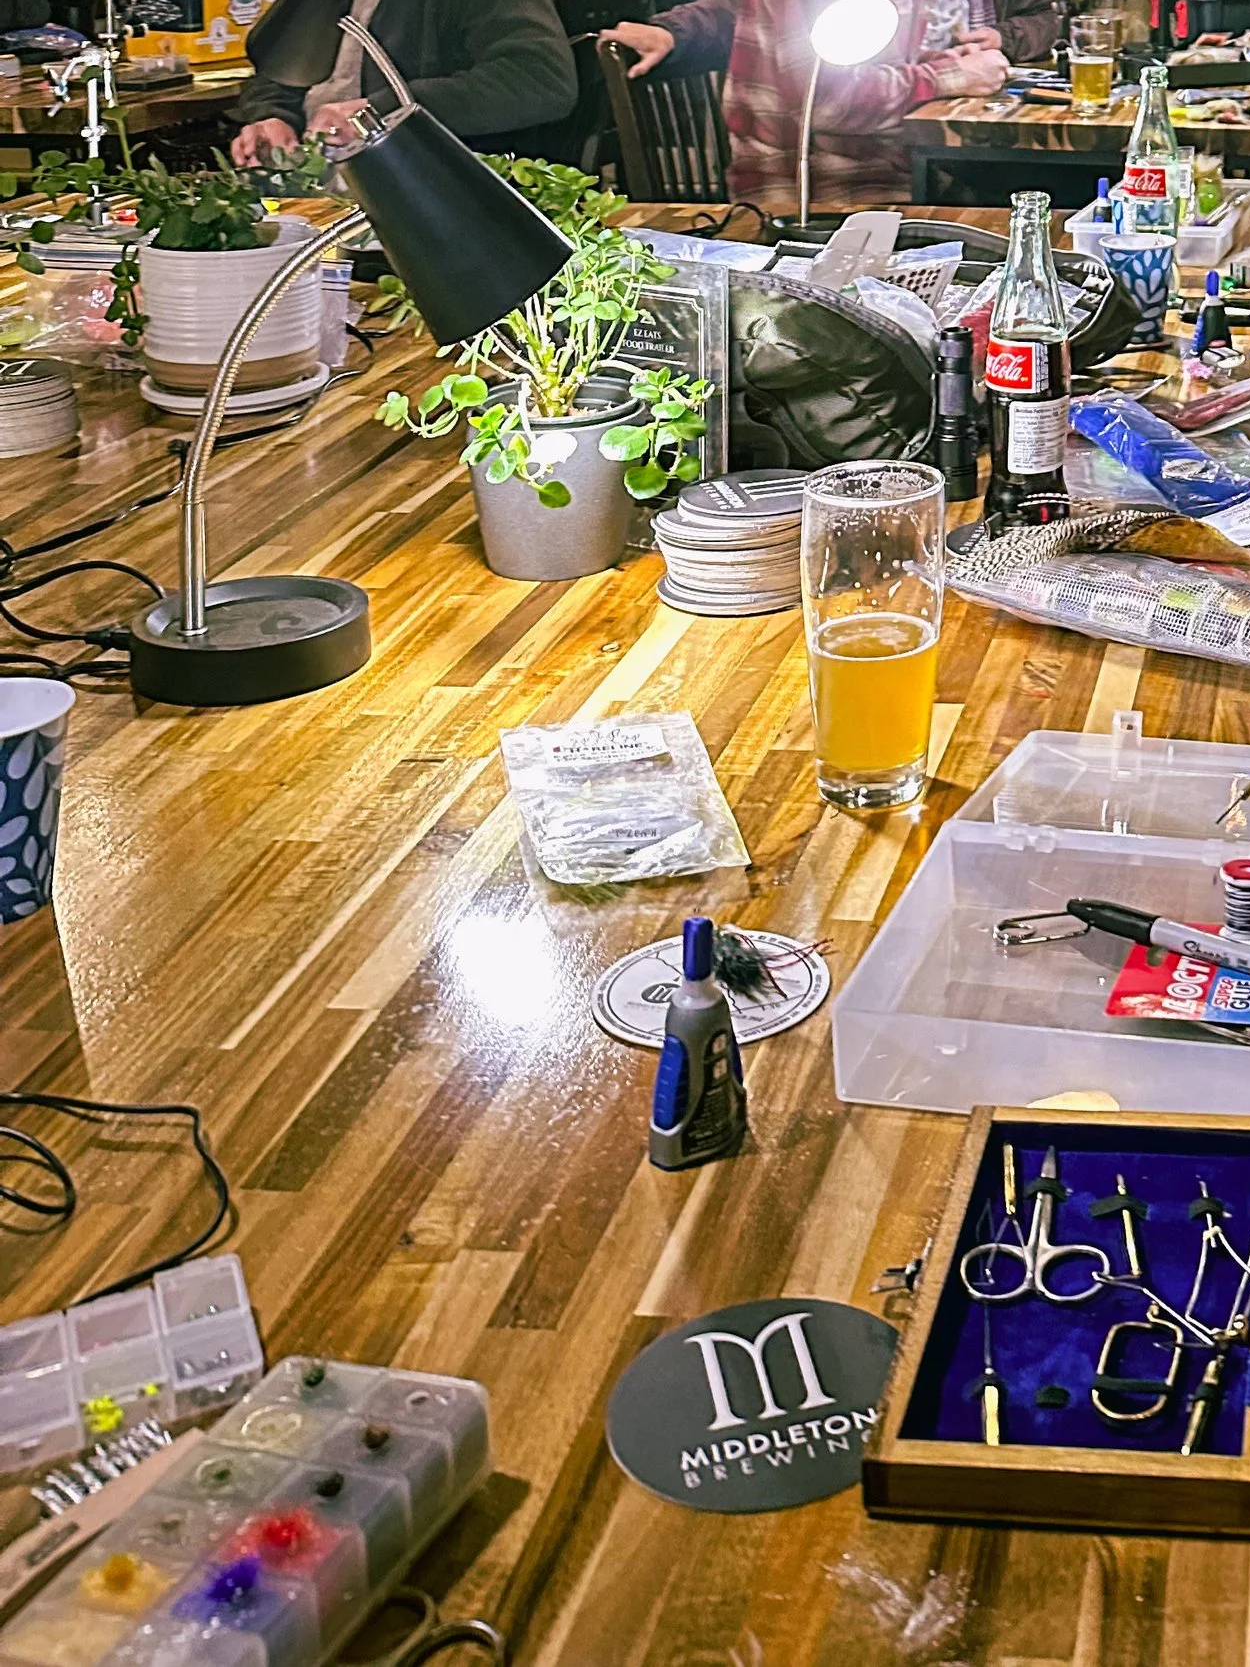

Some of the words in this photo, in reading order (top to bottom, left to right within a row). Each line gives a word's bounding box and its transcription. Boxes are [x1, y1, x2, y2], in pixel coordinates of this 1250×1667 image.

[622, 338, 644, 351] FOOD
[645, 341, 675, 354] TRAILER
[633, 328, 642, 338] EZ
[643, 329, 662, 340] EATS
[1161, 955, 1211, 1015] LOCT
[1213, 977, 1234, 1009] SUPER
[683, 1312, 836, 1431] M
[680, 1407, 881, 1471] MIDDLETON
